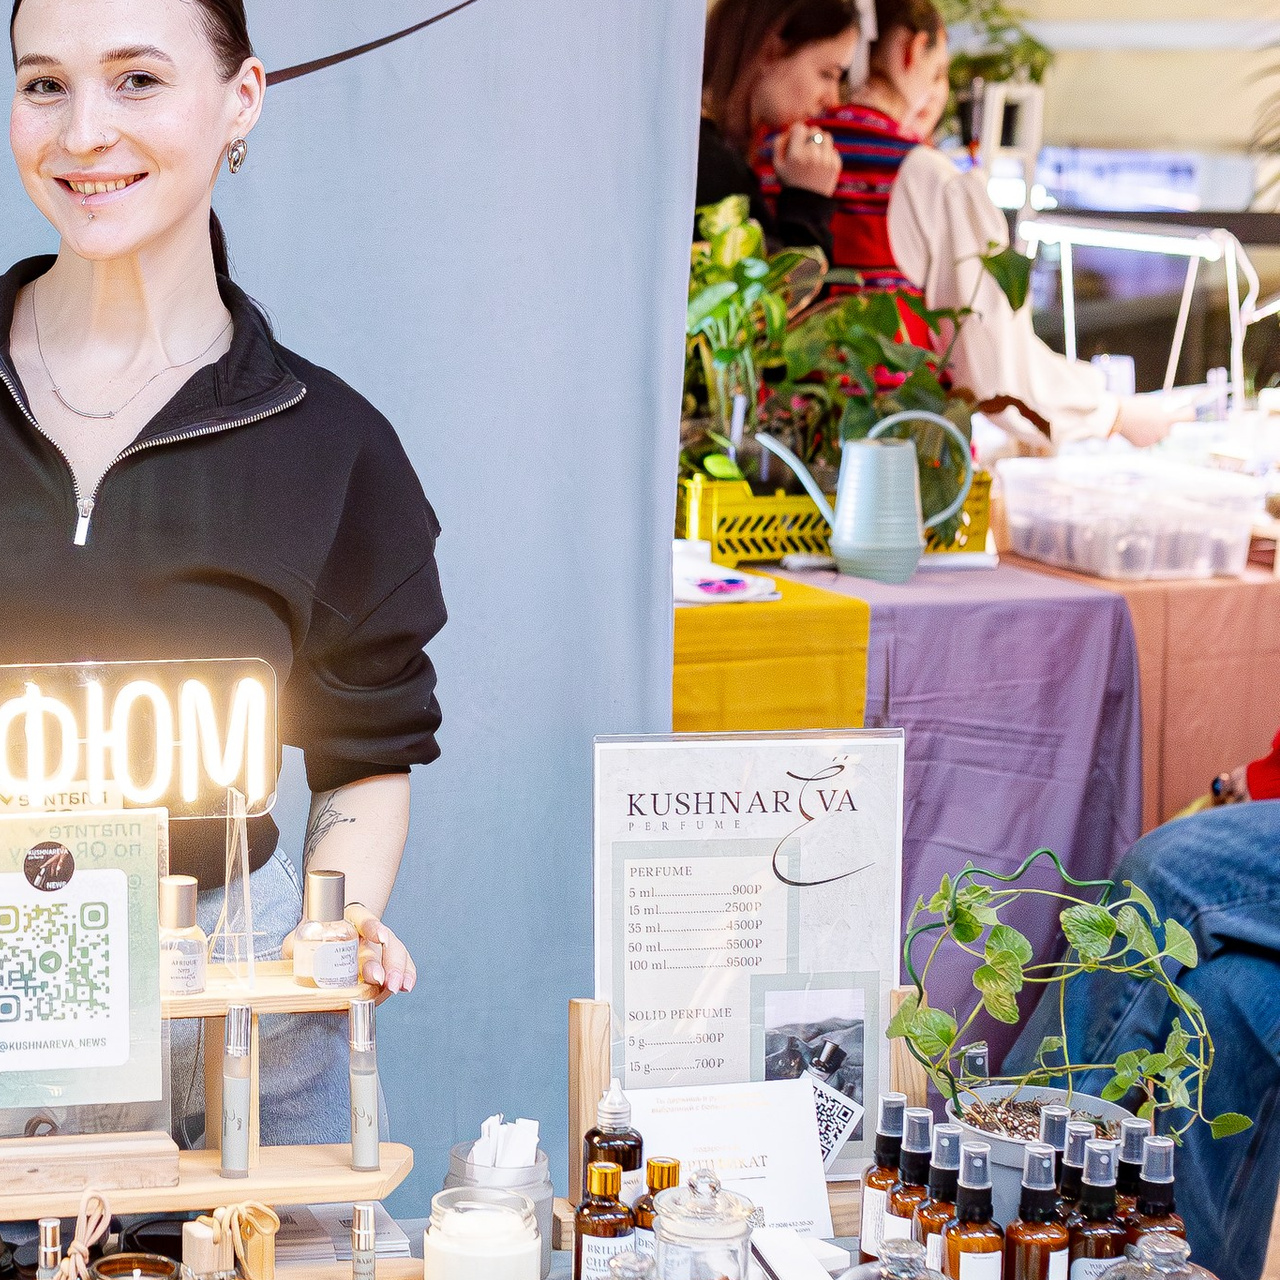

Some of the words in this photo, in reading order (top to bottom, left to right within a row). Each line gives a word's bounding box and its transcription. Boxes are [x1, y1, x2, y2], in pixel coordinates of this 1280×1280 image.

[628, 819, 741, 832] PERFUME
[630, 866, 693, 878] PERFUME
[629, 887, 636, 898] 5
[629, 905, 640, 916] 15
[628, 923, 642, 933] 35
[628, 942, 643, 953] 50
[629, 960, 648, 971] 100
[628, 1010, 667, 1021] SOLID
[670, 1007, 732, 1020] PERFUME
